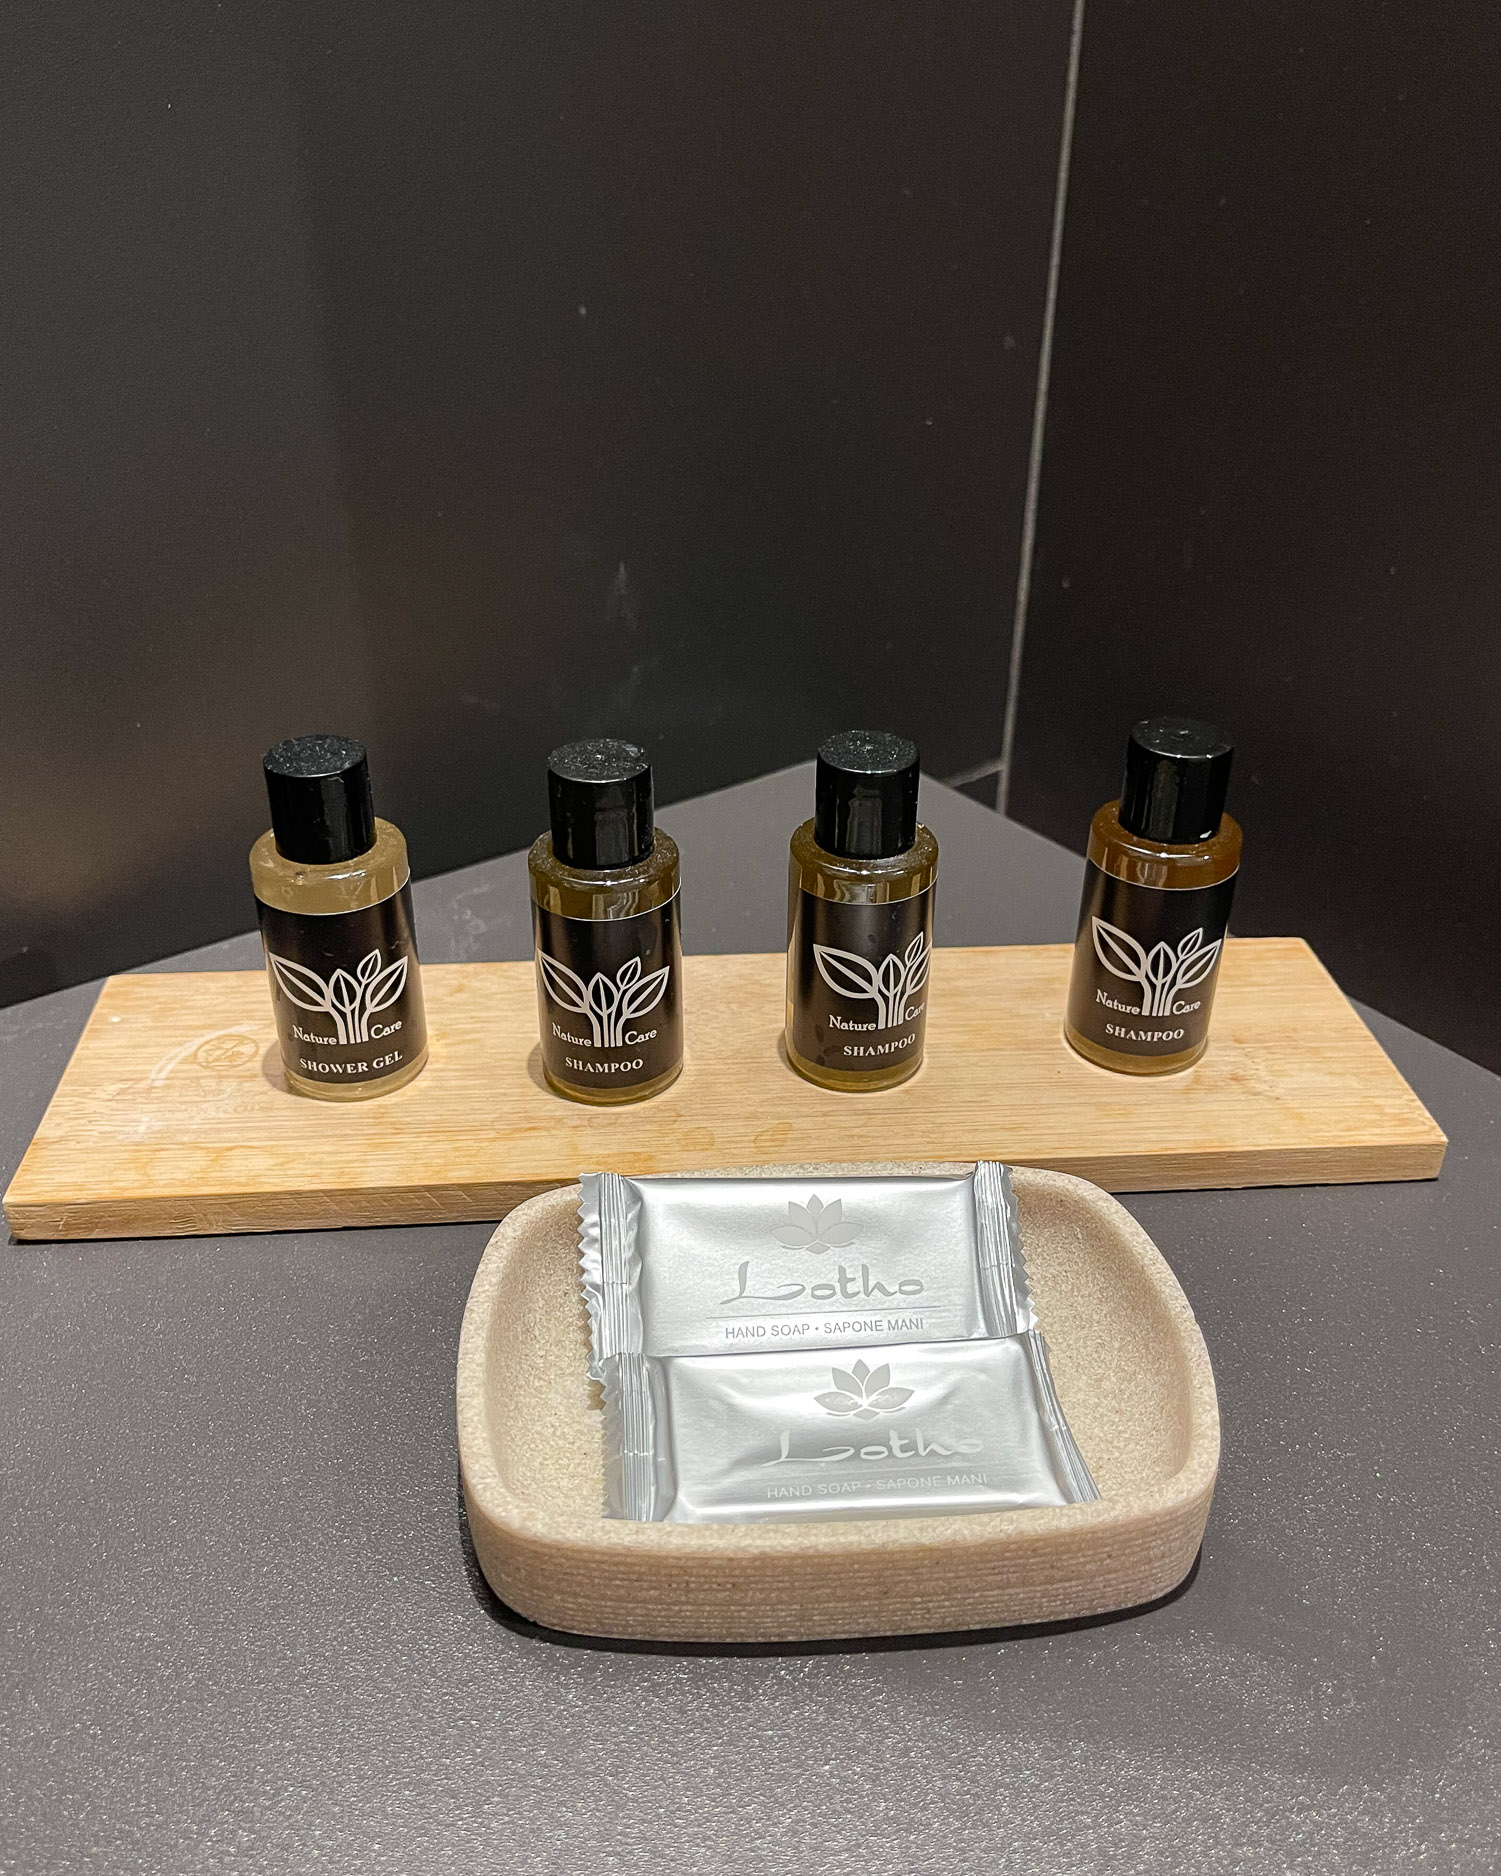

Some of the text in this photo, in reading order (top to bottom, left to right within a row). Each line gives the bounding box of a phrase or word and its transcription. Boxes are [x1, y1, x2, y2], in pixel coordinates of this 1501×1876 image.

[1095, 989, 1201, 1016] Nature Care
[292, 1020, 403, 1046] Nature Care
[551, 1022, 658, 1048] Nature Care
[828, 1015, 877, 1032] Nature
[1105, 1023, 1185, 1042] SHAMPOO
[843, 1033, 917, 1057] SHAMPOO
[299, 1050, 403, 1074] SHOWER GEL
[564, 1056, 644, 1073] SHAMPOO
[719, 1260, 925, 1305] Lotho
[725, 1317, 924, 1339] HAND SOAP SAPONE MANI
[760, 1428, 985, 1468] Lotho
[767, 1472, 988, 1499] HAND SOAP SAPONE MANI
